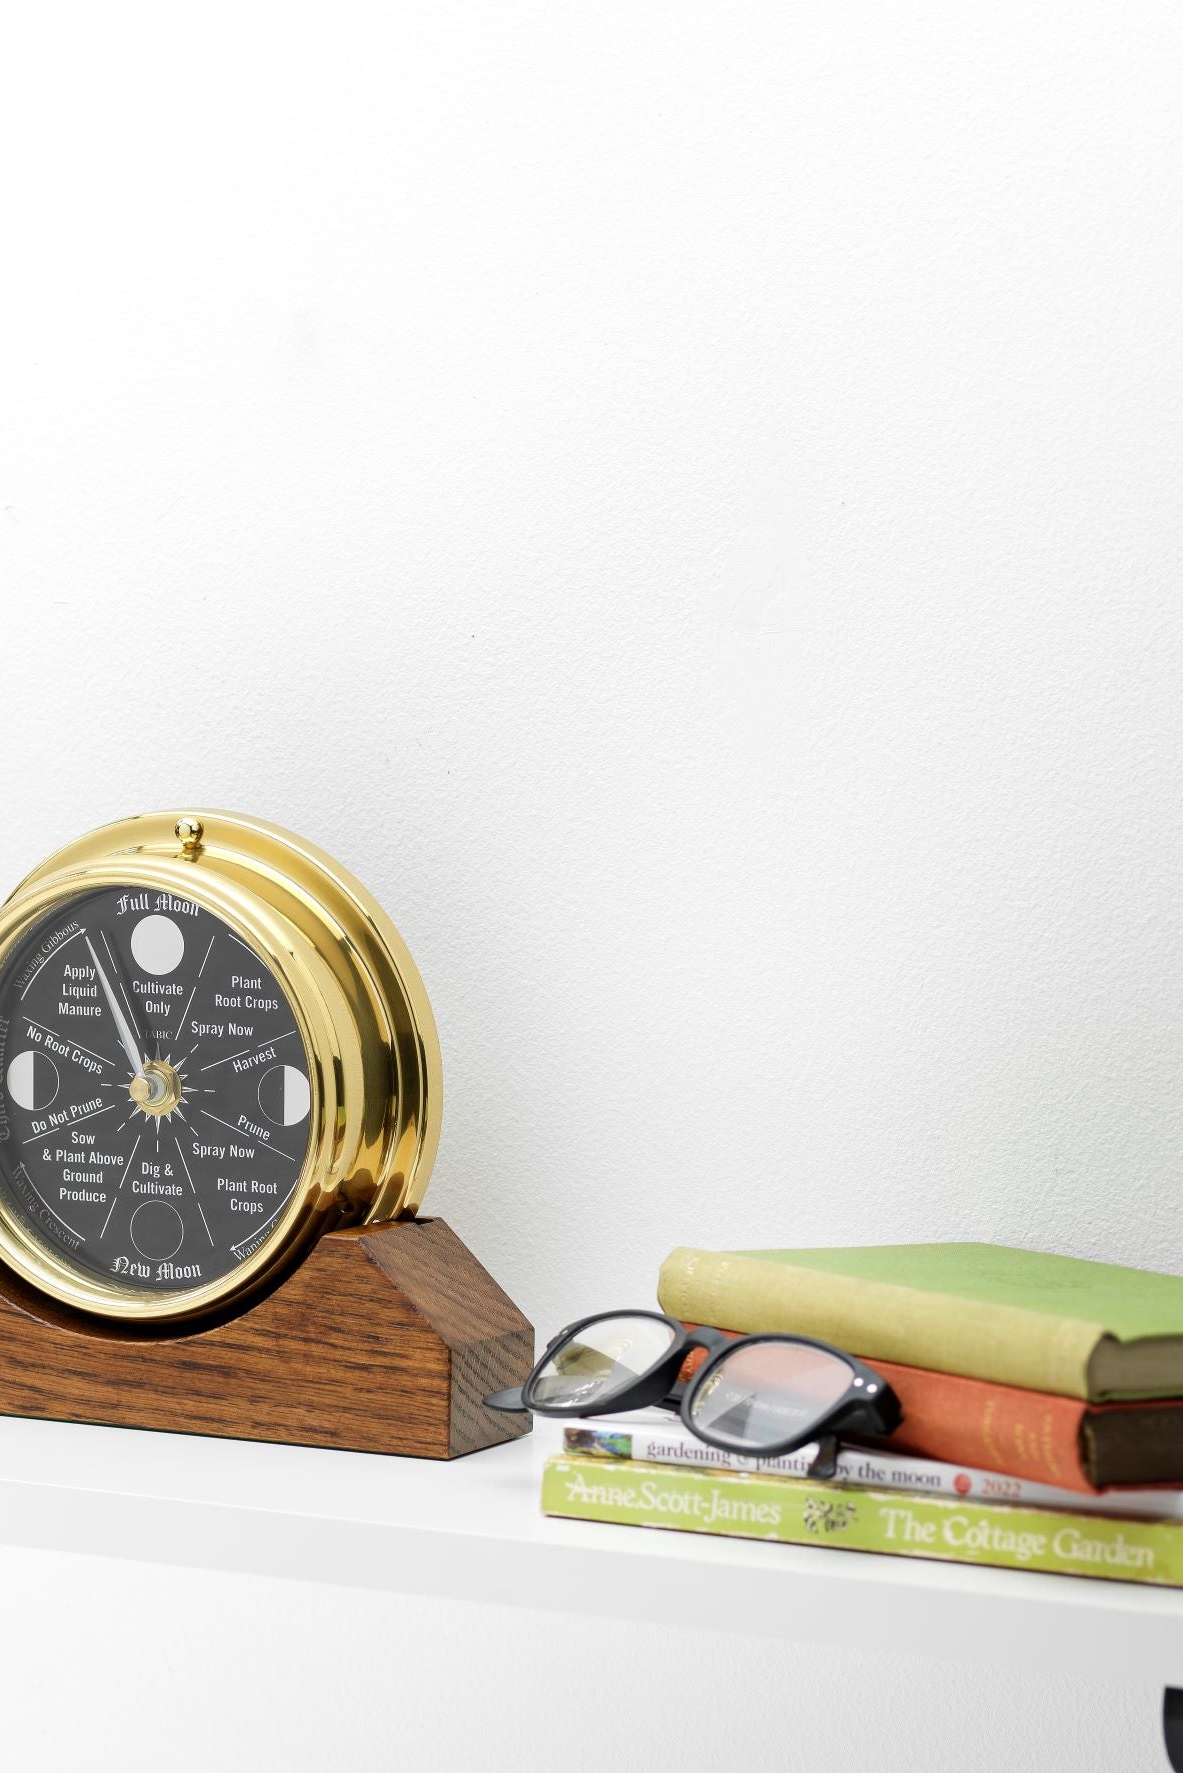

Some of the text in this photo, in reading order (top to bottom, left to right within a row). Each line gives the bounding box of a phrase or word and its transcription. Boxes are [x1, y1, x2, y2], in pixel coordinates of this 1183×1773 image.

[116, 894, 200, 916] Full Moon
[41, 920, 80, 954] Gibbous
[63, 964, 96, 980] Apply
[62, 983, 98, 998] Liquid
[132, 980, 184, 996] Cultivate
[231, 975, 262, 990] Plant
[58, 1002, 102, 1016] Manure
[145, 1000, 171, 1016] Only
[215, 994, 279, 1012] Root Crops
[191, 1020, 254, 1038] Spray Now
[26, 1025, 104, 1075] No Root Crops
[232, 1046, 278, 1073] Harvest
[31, 1097, 104, 1134] Do Not Prune
[237, 1114, 271, 1141] Prune
[71, 1131, 96, 1145] Sow
[42, 1148, 124, 1166] & Plant Above
[192, 1142, 255, 1160] Spray Now
[63, 1168, 104, 1184] Ground
[141, 1162, 174, 1178] Dig &
[132, 1180, 183, 1196] Cultivate
[218, 1178, 278, 1194] Plant Root
[59, 1188, 106, 1203] Produce
[230, 1198, 264, 1214] Crops
[39, 1208, 80, 1250] Crescent
[109, 1256, 202, 1282] New Moon
[646, 1441, 731, 1466] gardening
[756, 1456, 808, 1475] planti
[857, 1462, 885, 1482] the
[891, 1470, 942, 1487] moon
[981, 1478, 1022, 1497] 2022
[565, 1470, 781, 1526] Anne Scott-James
[878, 1507, 1157, 1569] The Cottage Garden
